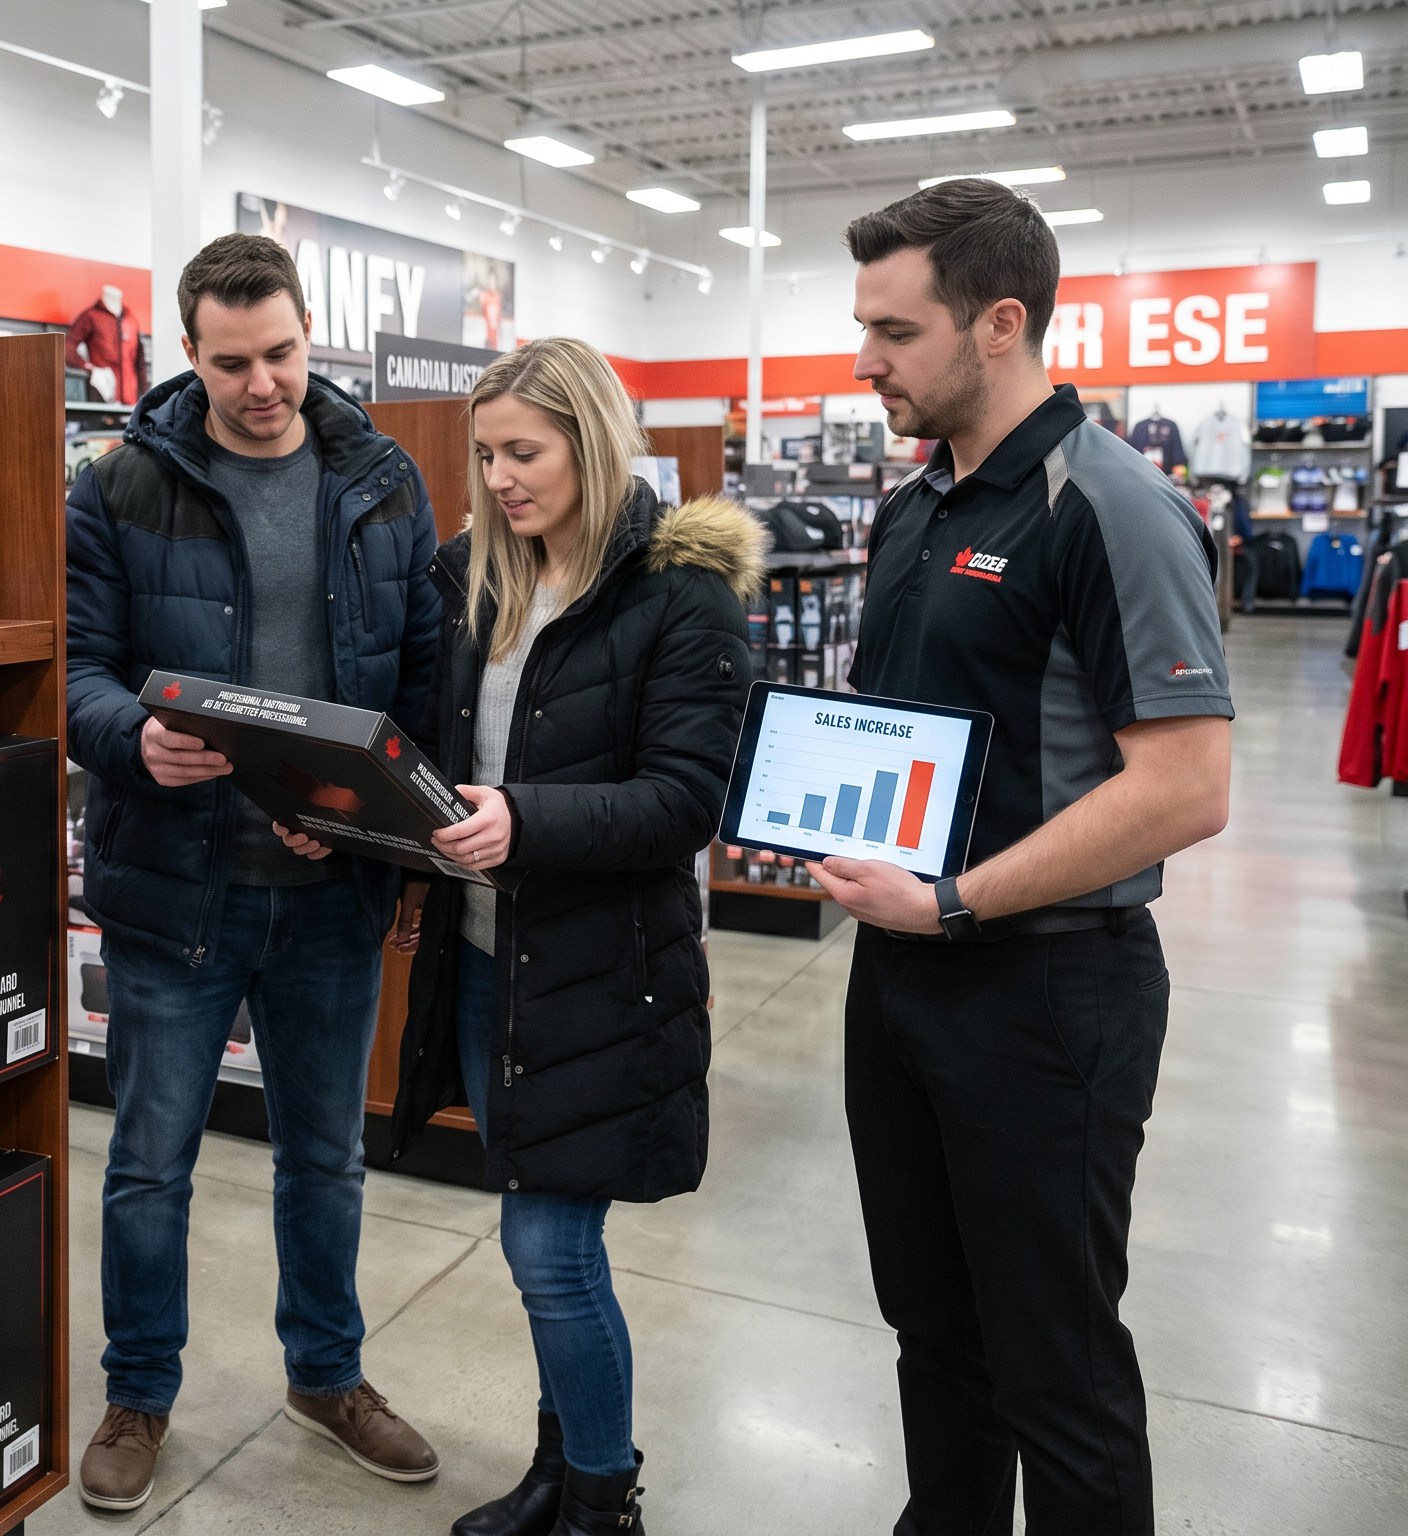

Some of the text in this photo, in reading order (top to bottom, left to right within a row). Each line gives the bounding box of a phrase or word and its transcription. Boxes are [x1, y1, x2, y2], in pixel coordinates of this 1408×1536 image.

[1129, 292, 1270, 368] ESE
[387, 354, 450, 392] CANADIAN
[814, 711, 914, 739] SALES INCREASE
